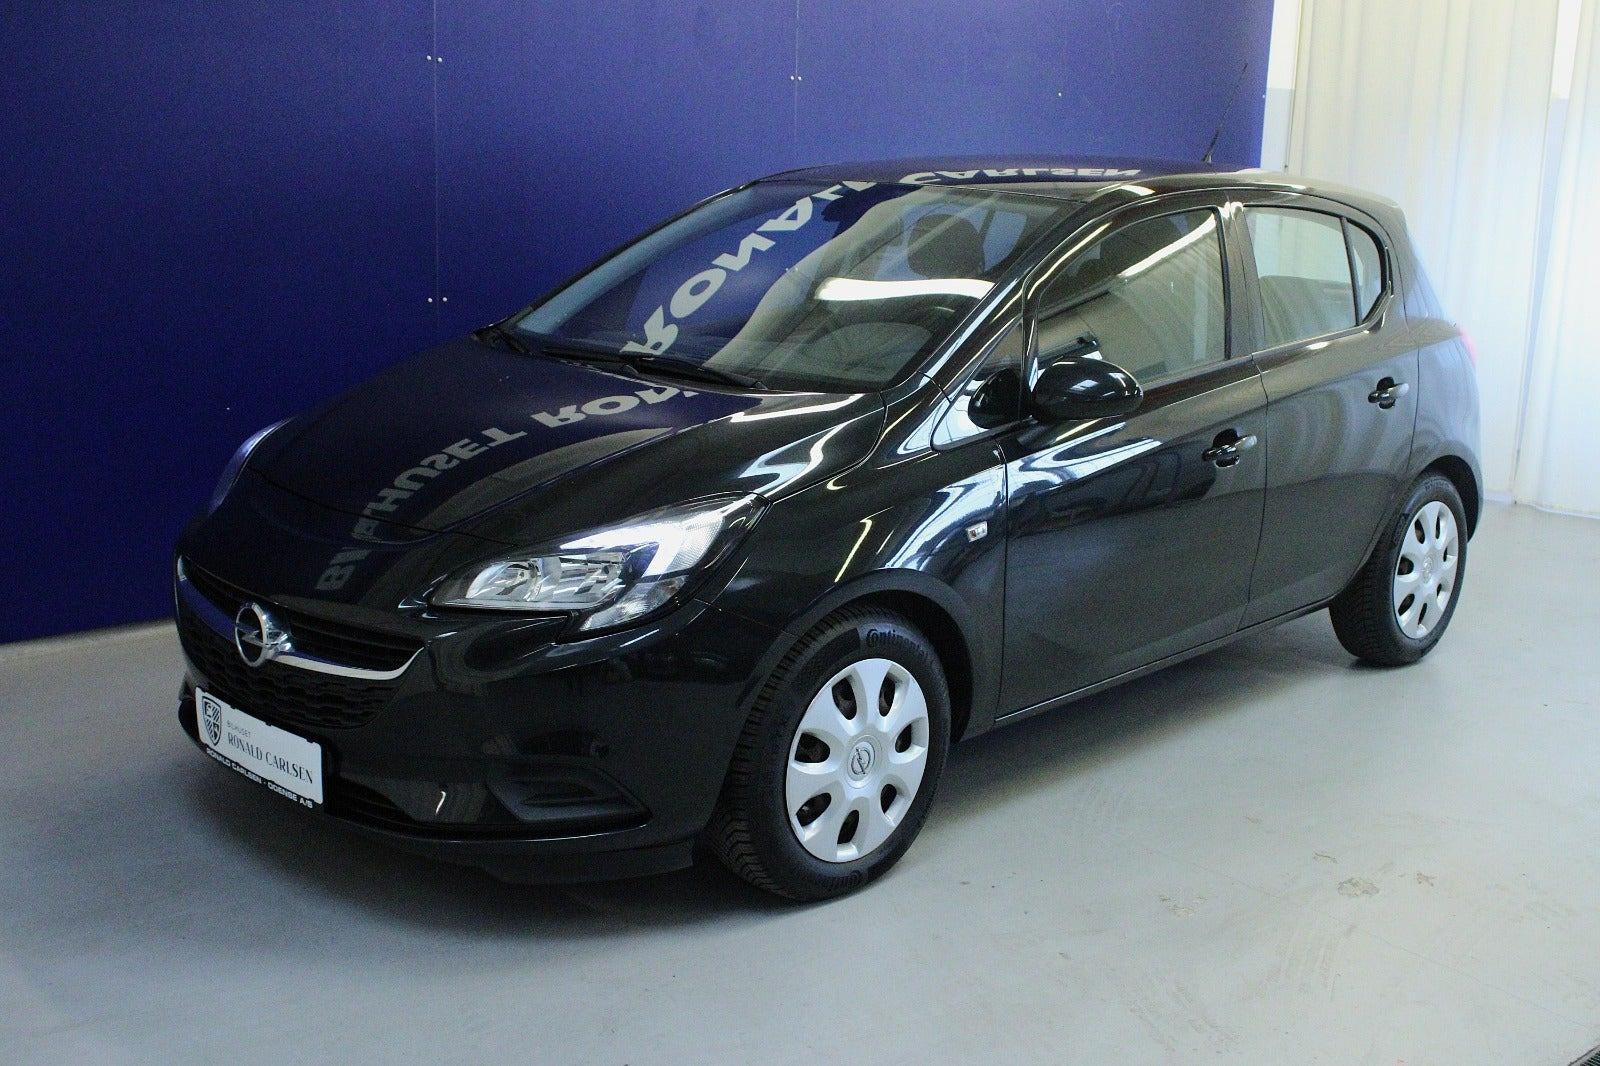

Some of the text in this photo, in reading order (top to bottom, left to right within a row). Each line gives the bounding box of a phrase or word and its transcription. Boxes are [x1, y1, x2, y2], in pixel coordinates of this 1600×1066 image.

[206, 747, 231, 767] RONALD
[232, 763, 262, 785] CARLSEN
[228, 732, 313, 784] RONALD CARLSEN
